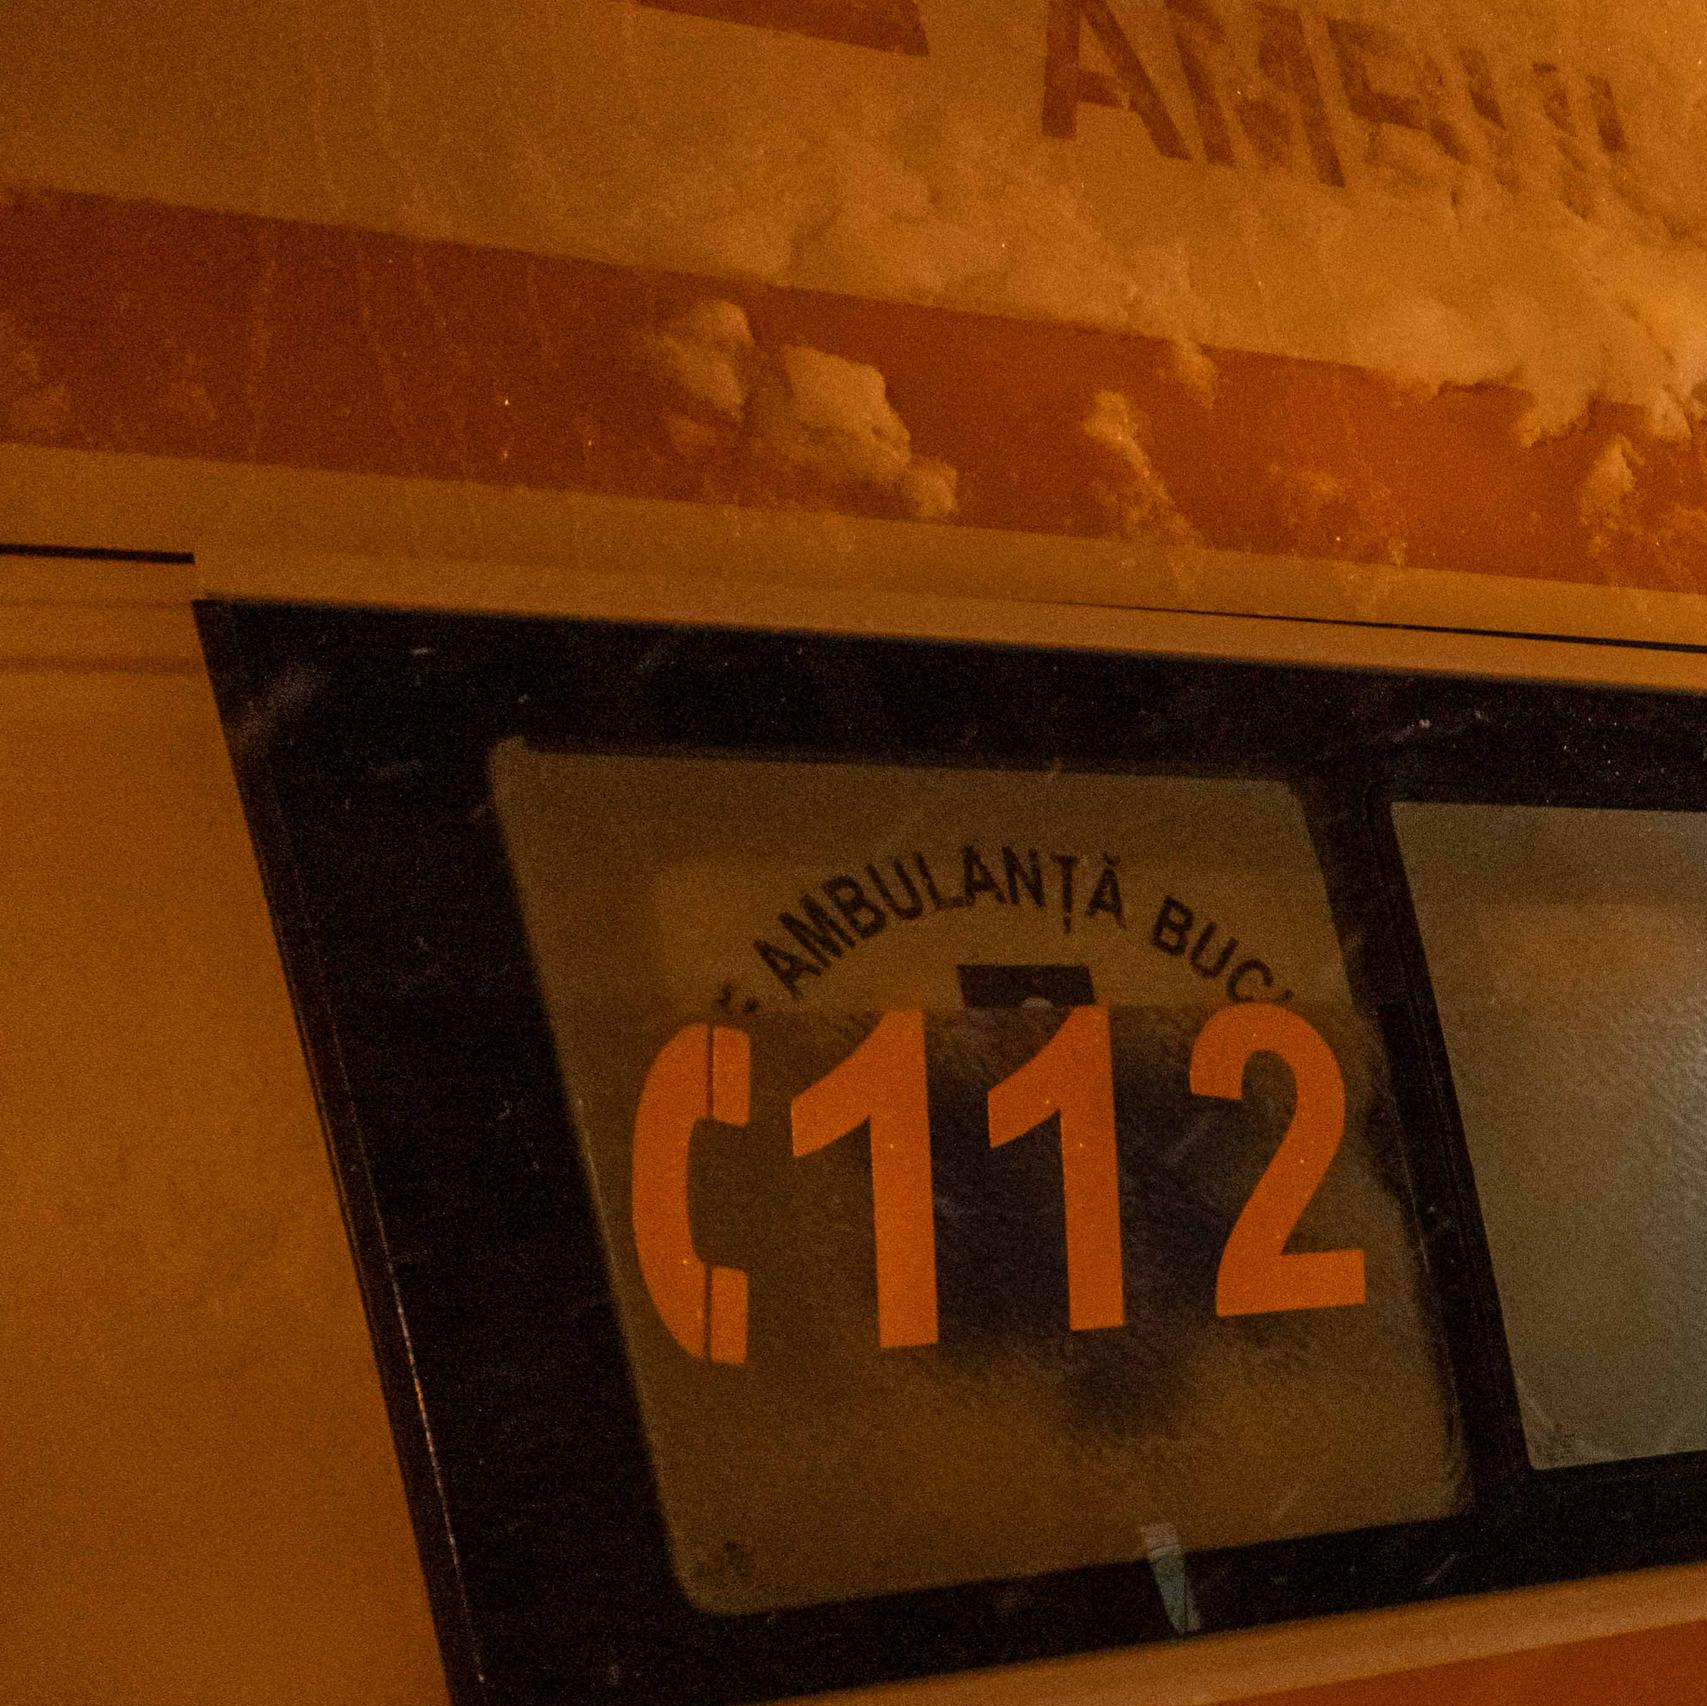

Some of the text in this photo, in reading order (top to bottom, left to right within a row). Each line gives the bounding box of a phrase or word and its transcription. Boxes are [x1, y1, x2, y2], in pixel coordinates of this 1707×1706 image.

[753, 843, 1297, 1004] AMBULANȚĂ BUC
[791, 1002, 1366, 1349] 112
